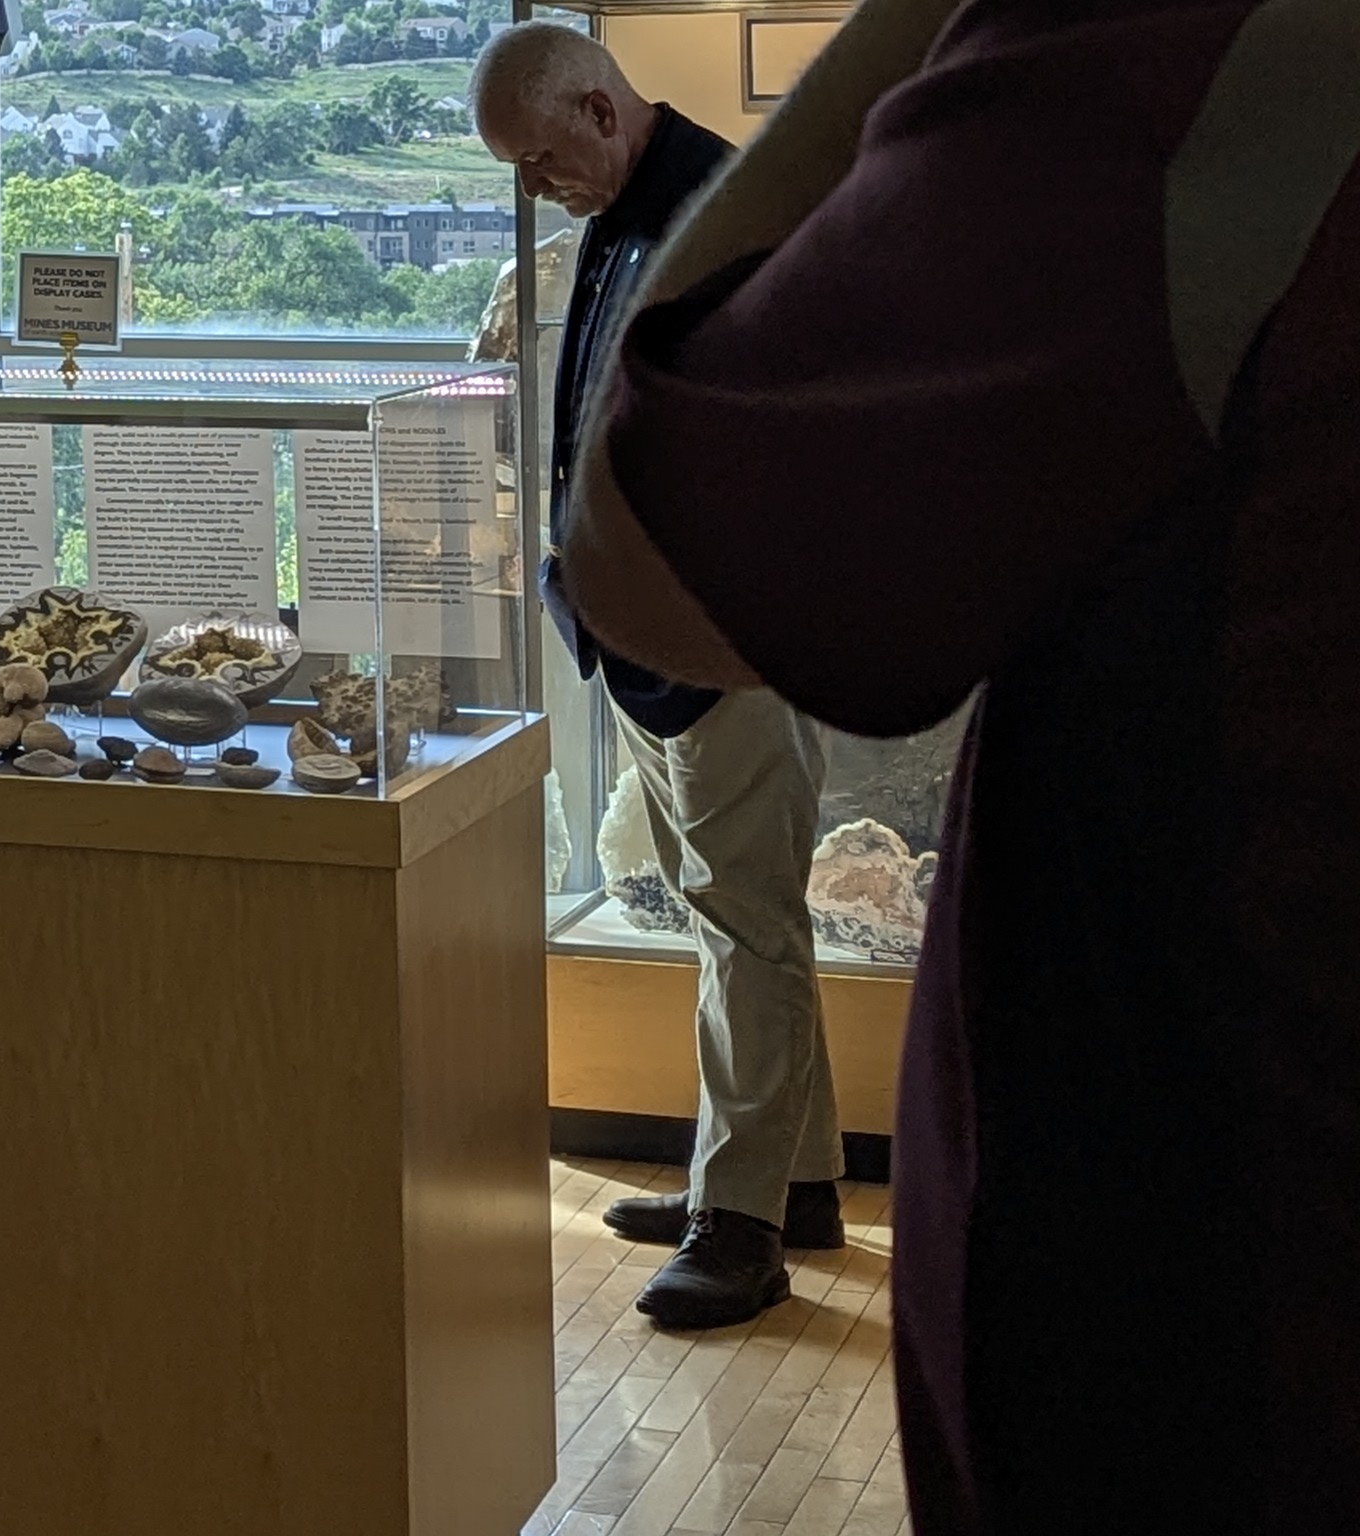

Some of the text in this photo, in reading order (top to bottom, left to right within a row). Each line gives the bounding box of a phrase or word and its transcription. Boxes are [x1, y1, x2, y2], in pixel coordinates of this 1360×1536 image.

[34, 267, 105, 278] PLEASE DO NOT
[32, 277, 107, 289] PLACE ITEMS ON
[34, 288, 71, 297] DISPLAY
[24, 318, 112, 332] MINES MUSEUM
